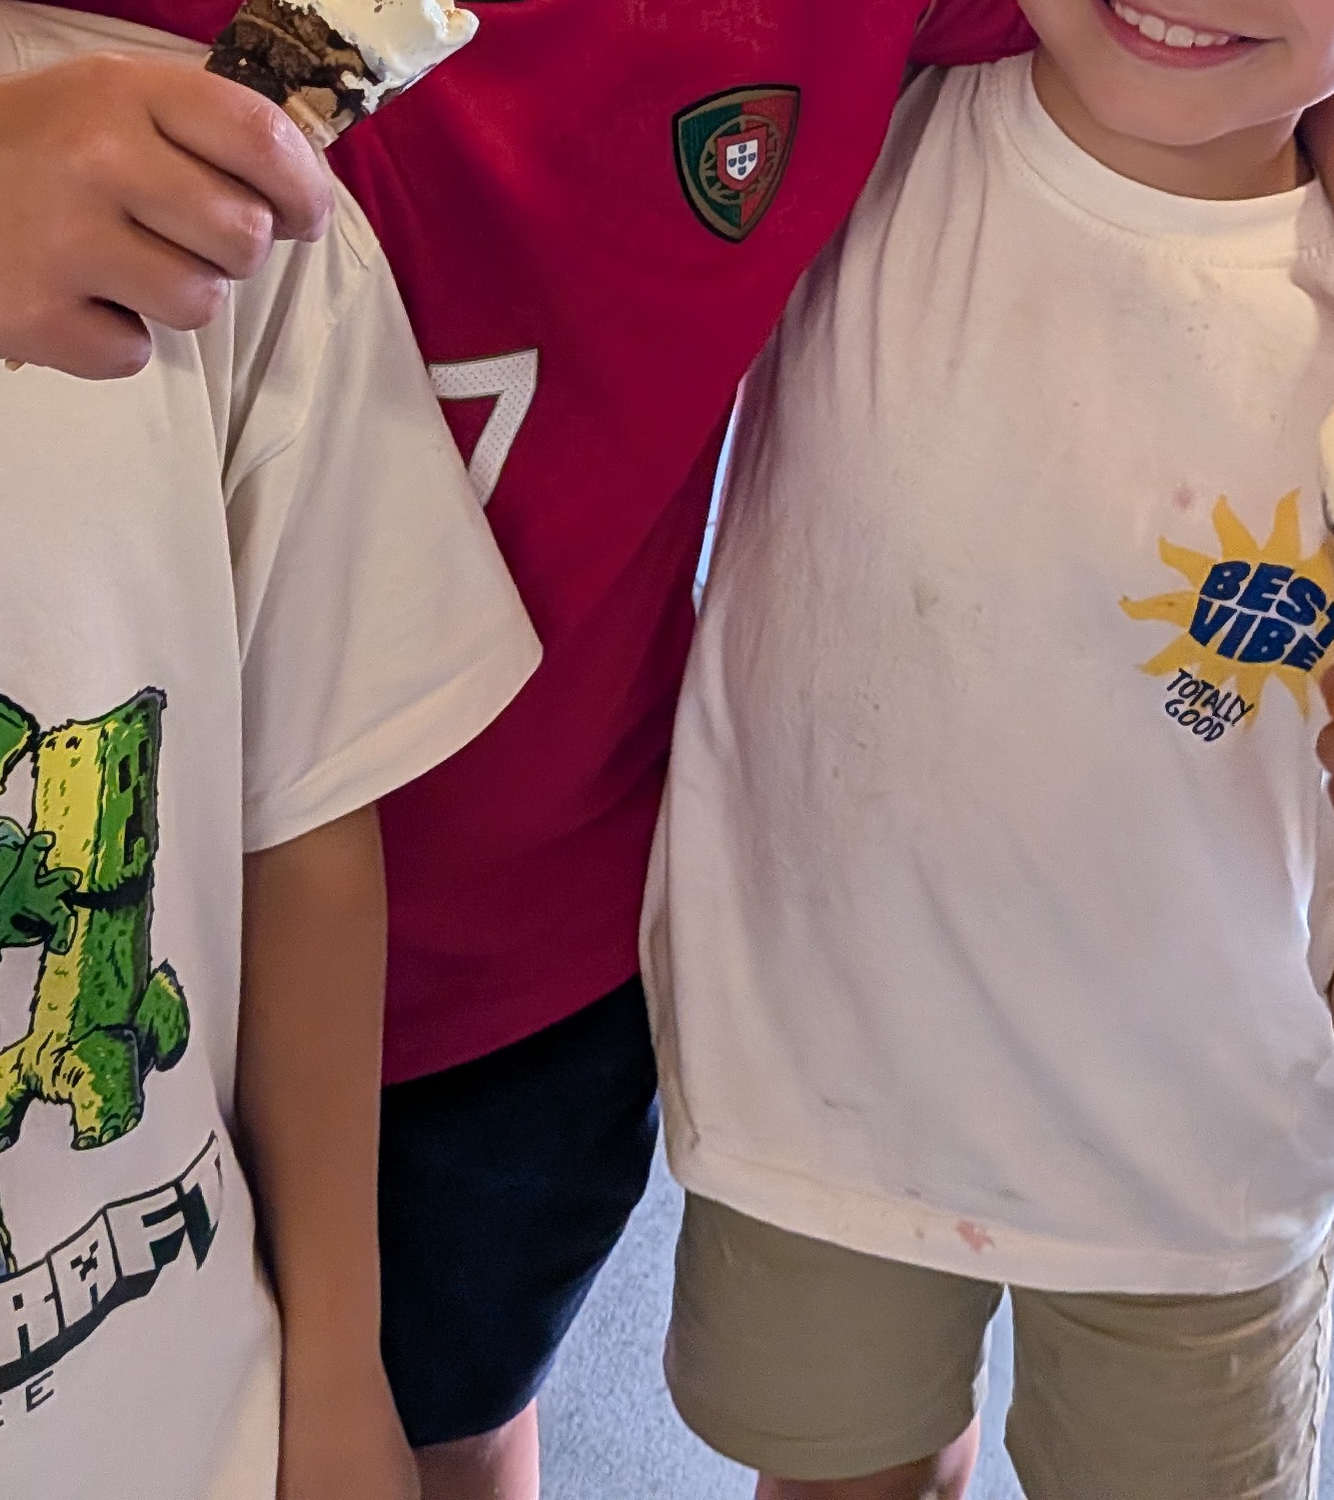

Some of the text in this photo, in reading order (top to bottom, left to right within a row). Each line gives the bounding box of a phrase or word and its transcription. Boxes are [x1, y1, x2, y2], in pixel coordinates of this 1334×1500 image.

[428, 347, 538, 509] 7
[1164, 698, 1225, 742] GOOD
[1166, 667, 1255, 727] TOTALLY
